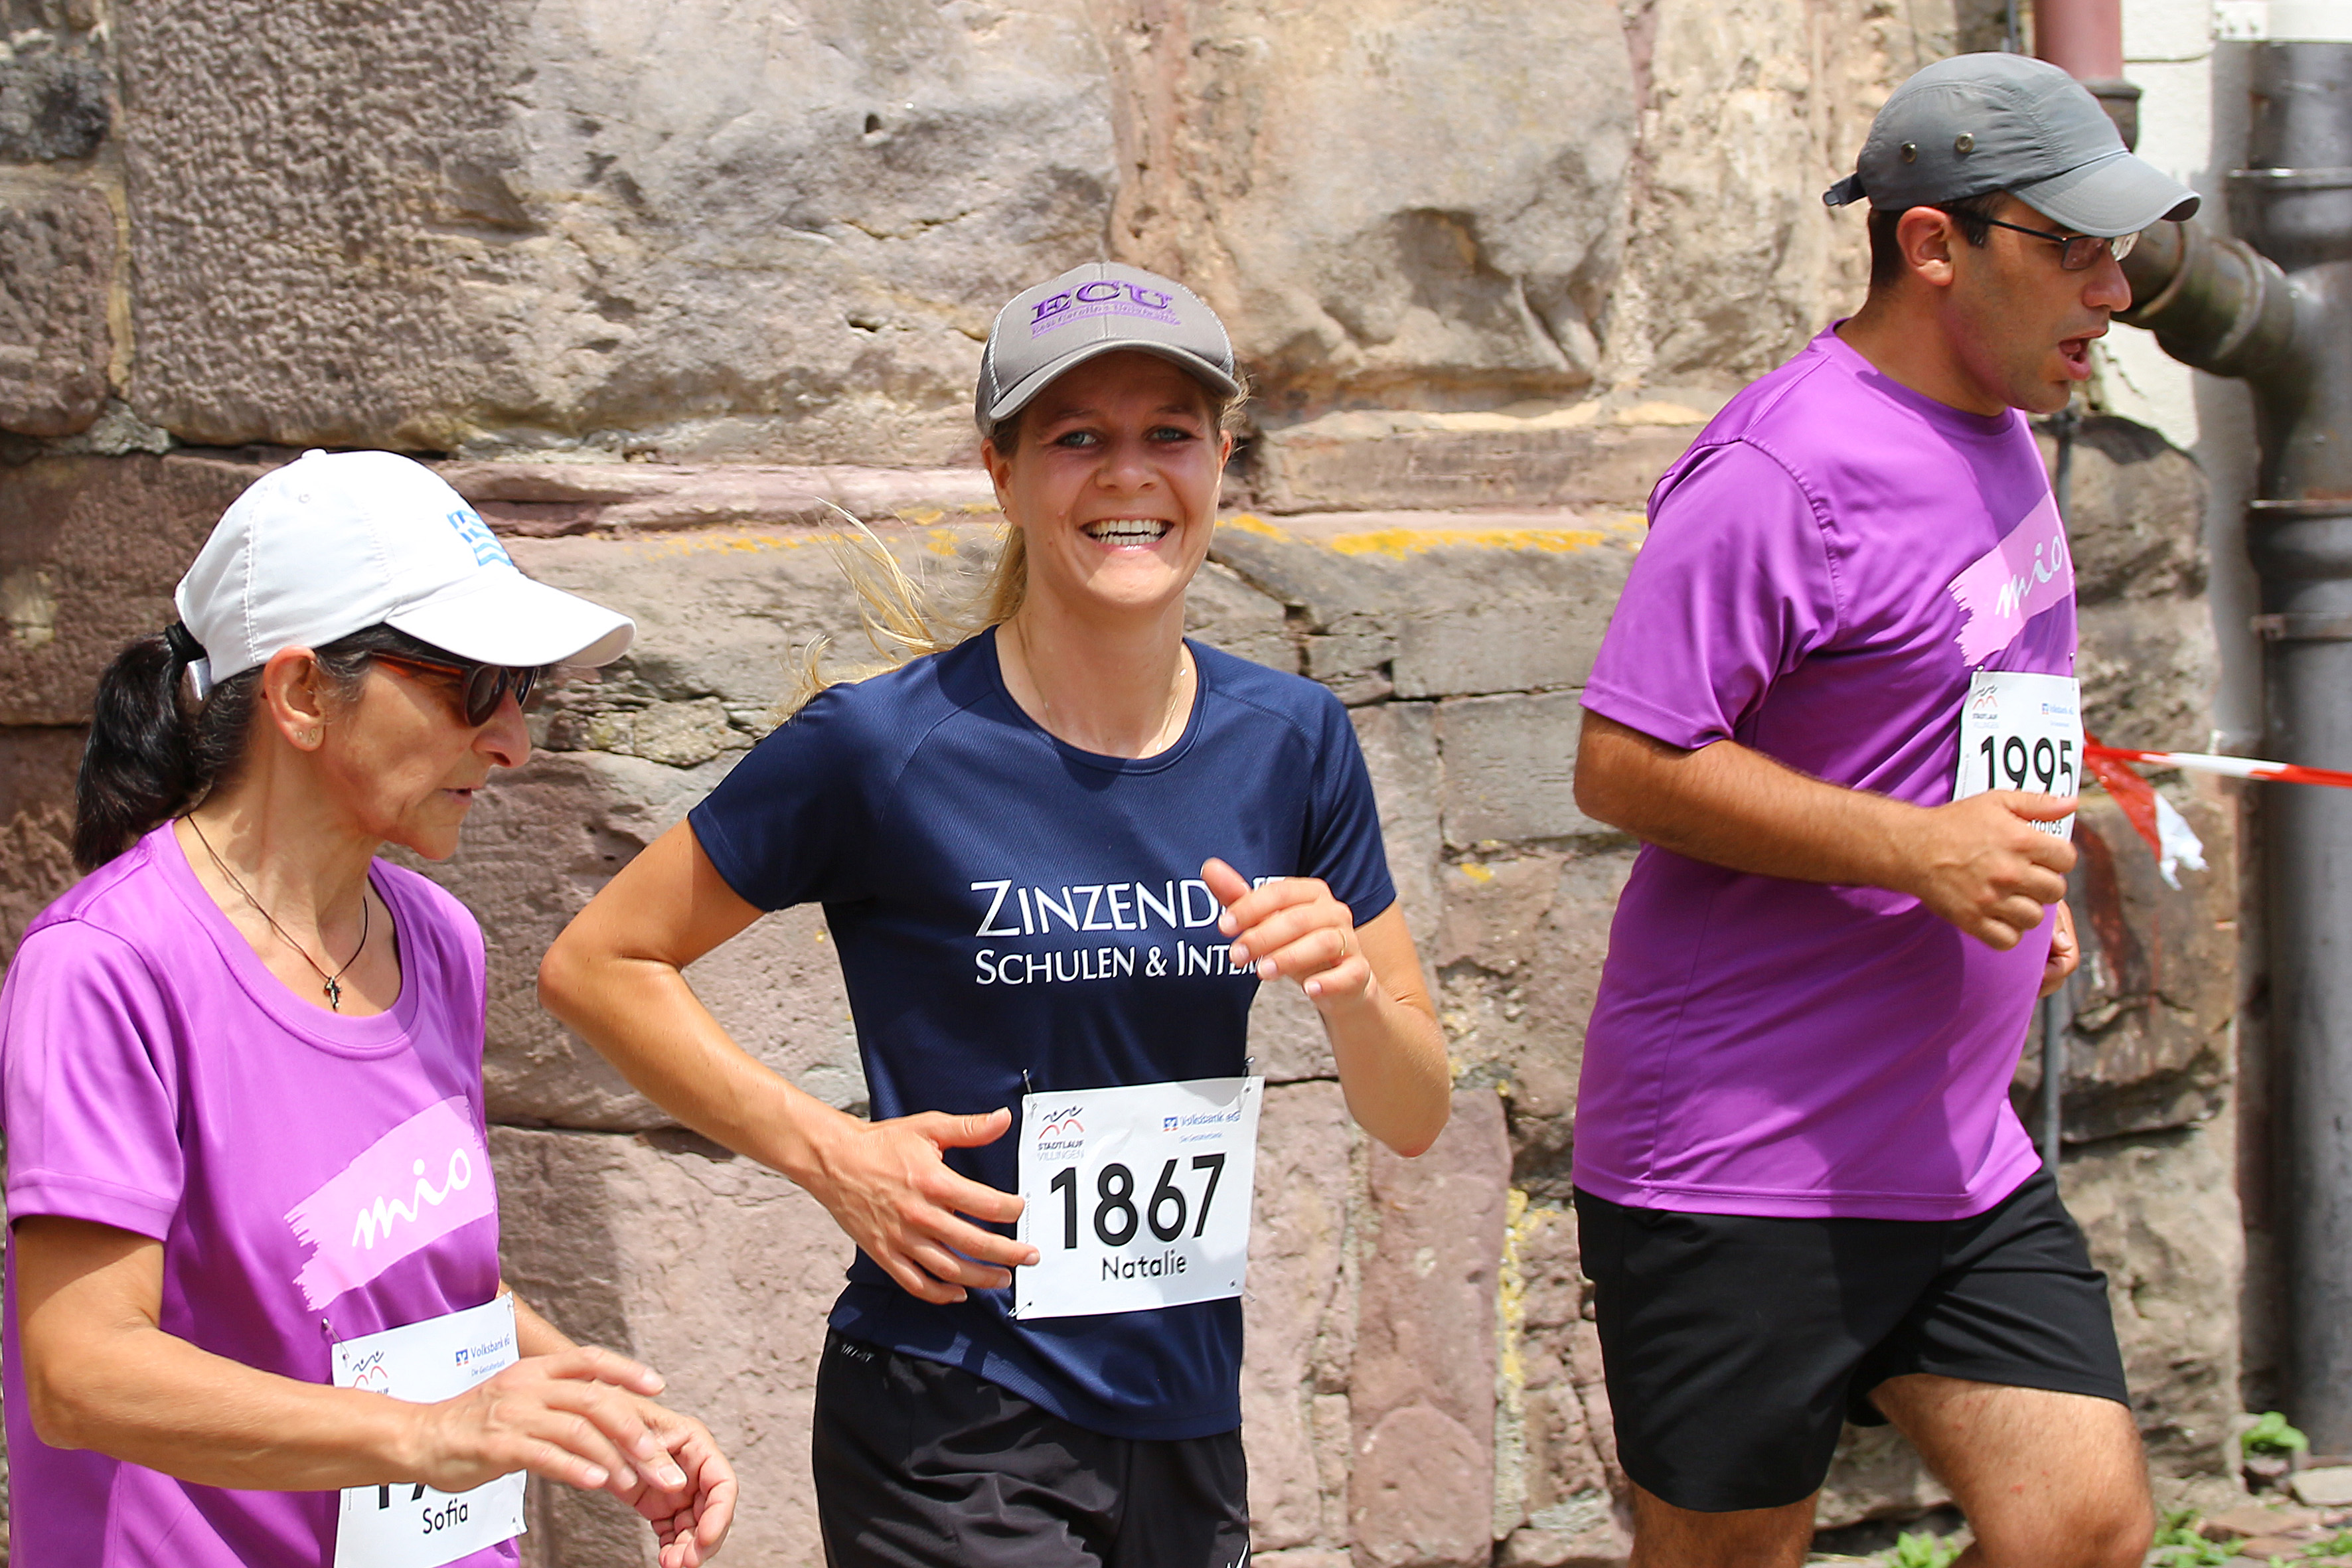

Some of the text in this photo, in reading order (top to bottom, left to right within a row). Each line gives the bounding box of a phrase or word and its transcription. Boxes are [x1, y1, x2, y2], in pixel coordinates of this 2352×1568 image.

[1030, 280, 1174, 325] ECU
[1994, 535, 2064, 619] mio
[1980, 736, 2073, 797] 1995
[970, 876, 1286, 937] ZINZEND
[975, 946, 1136, 984] SCHULEN
[1144, 946, 1168, 977] &
[1037, 1139, 1085, 1151] STADTLAUF
[1037, 1148, 1085, 1162] VILLINGEN
[352, 1148, 472, 1250] mio
[1050, 1152, 1227, 1249] 1867
[1101, 1249, 1188, 1281] Natalie
[470, 1336, 504, 1359] Volksbank
[422, 1496, 469, 1535] Sofia
